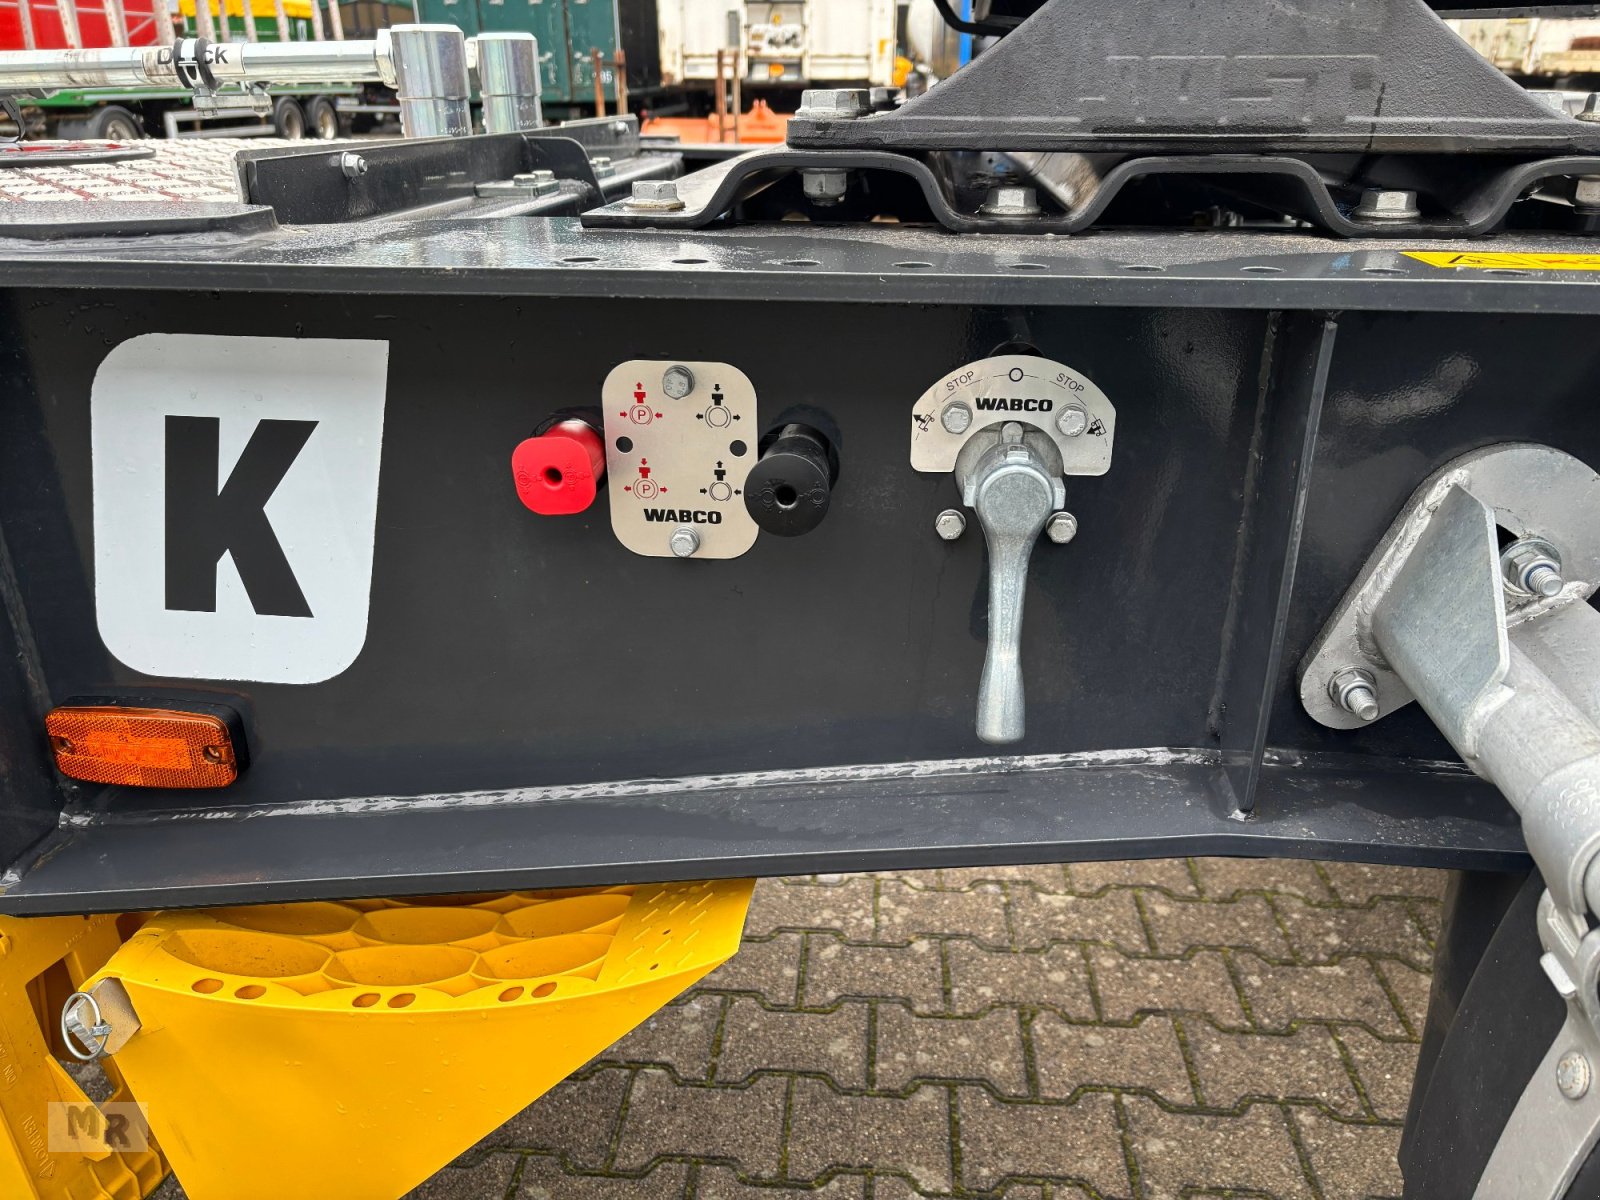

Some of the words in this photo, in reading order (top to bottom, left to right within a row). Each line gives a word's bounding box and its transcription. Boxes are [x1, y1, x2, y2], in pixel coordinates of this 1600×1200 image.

[946, 370, 975, 391] STOP
[1056, 372, 1085, 393] STOP
[975, 397, 1053, 412] WABCO
[164, 414, 319, 618] K
[643, 508, 722, 525] WABCO
